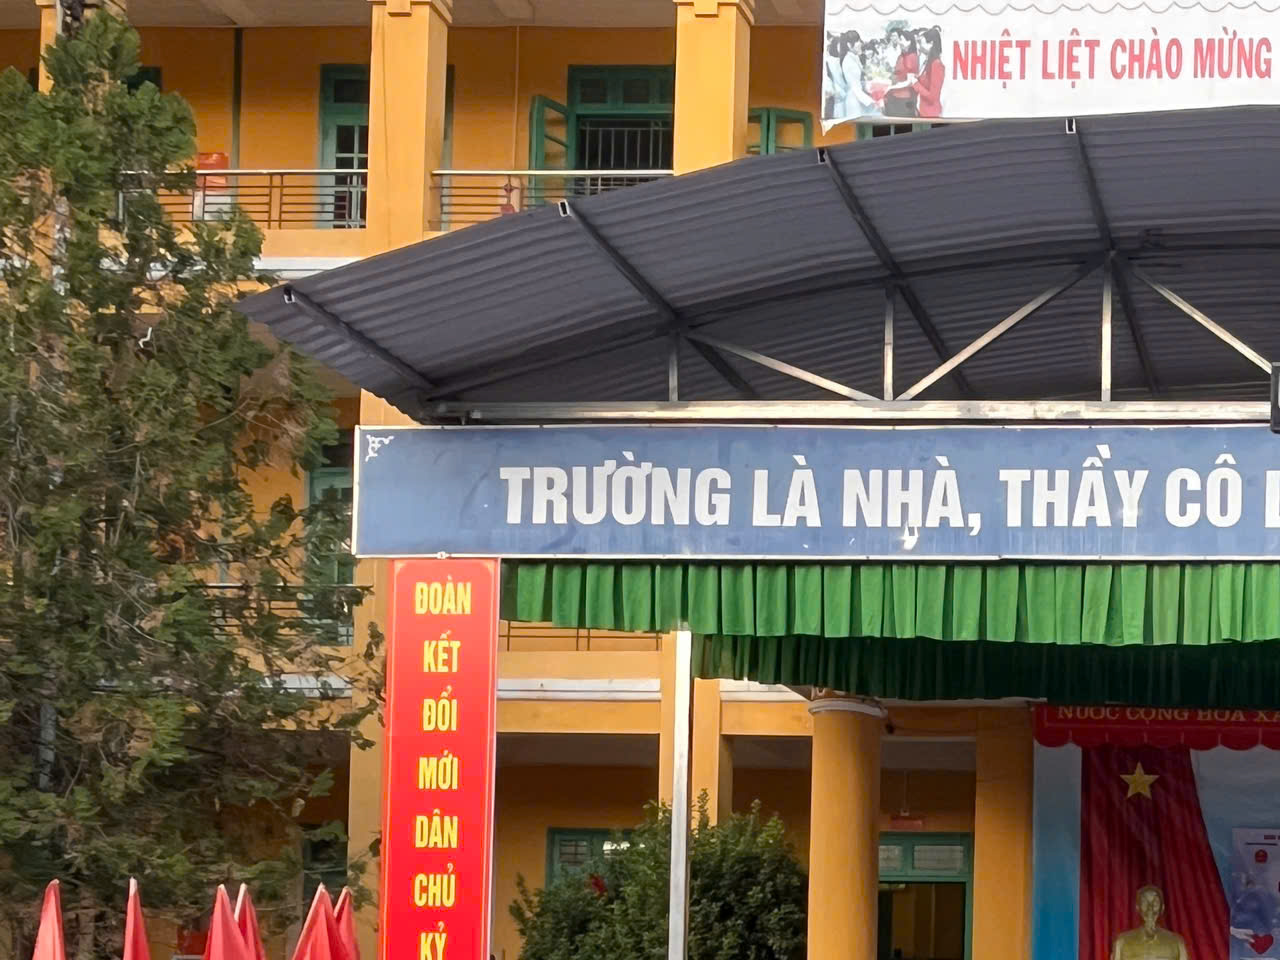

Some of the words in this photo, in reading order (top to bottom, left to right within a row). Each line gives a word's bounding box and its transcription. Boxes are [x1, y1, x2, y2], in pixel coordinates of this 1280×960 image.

[954, 37, 1029, 80] NHIỆT
[1041, 37, 1098, 80] LIỆT
[1110, 39, 1183, 79] CHÀO
[1193, 38, 1271, 79] MỪNG
[500, 451, 731, 528] TRƯỜNG
[752, 455, 822, 528] LÀ
[843, 456, 981, 536] NHÀ,
[999, 444, 1150, 528] THẦY
[1165, 453, 1243, 528] CÔ
[415, 575, 472, 617] ĐOÀN
[423, 630, 461, 675] KẾT
[422, 685, 458, 732] ĐỔI
[418, 754, 458, 790] MỚI
[415, 808, 459, 849] DÂN
[414, 864, 456, 907] CHỦ
